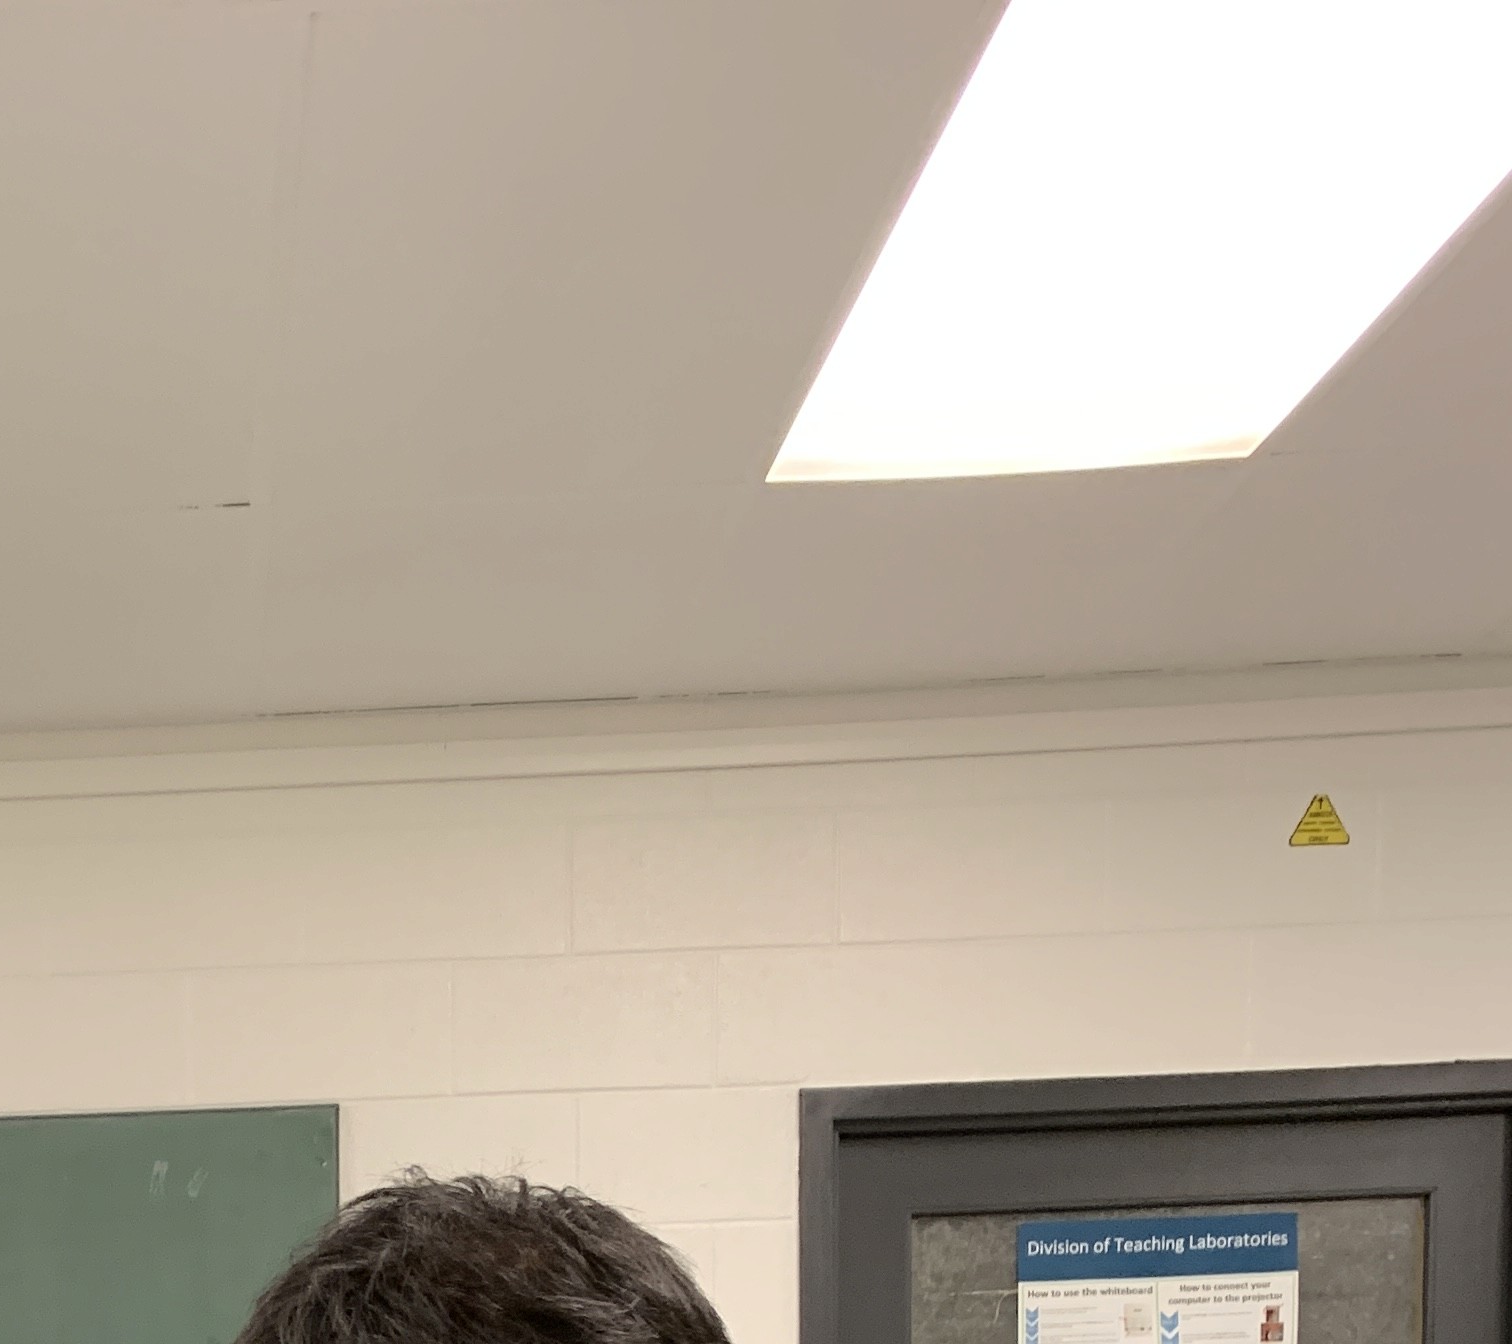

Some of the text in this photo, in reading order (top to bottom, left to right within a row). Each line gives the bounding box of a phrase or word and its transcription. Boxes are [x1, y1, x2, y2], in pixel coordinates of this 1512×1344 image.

[1027, 1230, 1288, 1256] Division of Teaching Laboratories
[1027, 1290, 1048, 1298] How
[1082, 1288, 1097, 1296] the
[1099, 1286, 1153, 1296] whiteboard
[1179, 1284, 1200, 1293] How
[1213, 1282, 1249, 1291] connect
[1251, 1282, 1271, 1290] your
[1168, 1296, 1211, 1305] computer
[1225, 1294, 1240, 1302] the
[1242, 1293, 1283, 1303] projector
